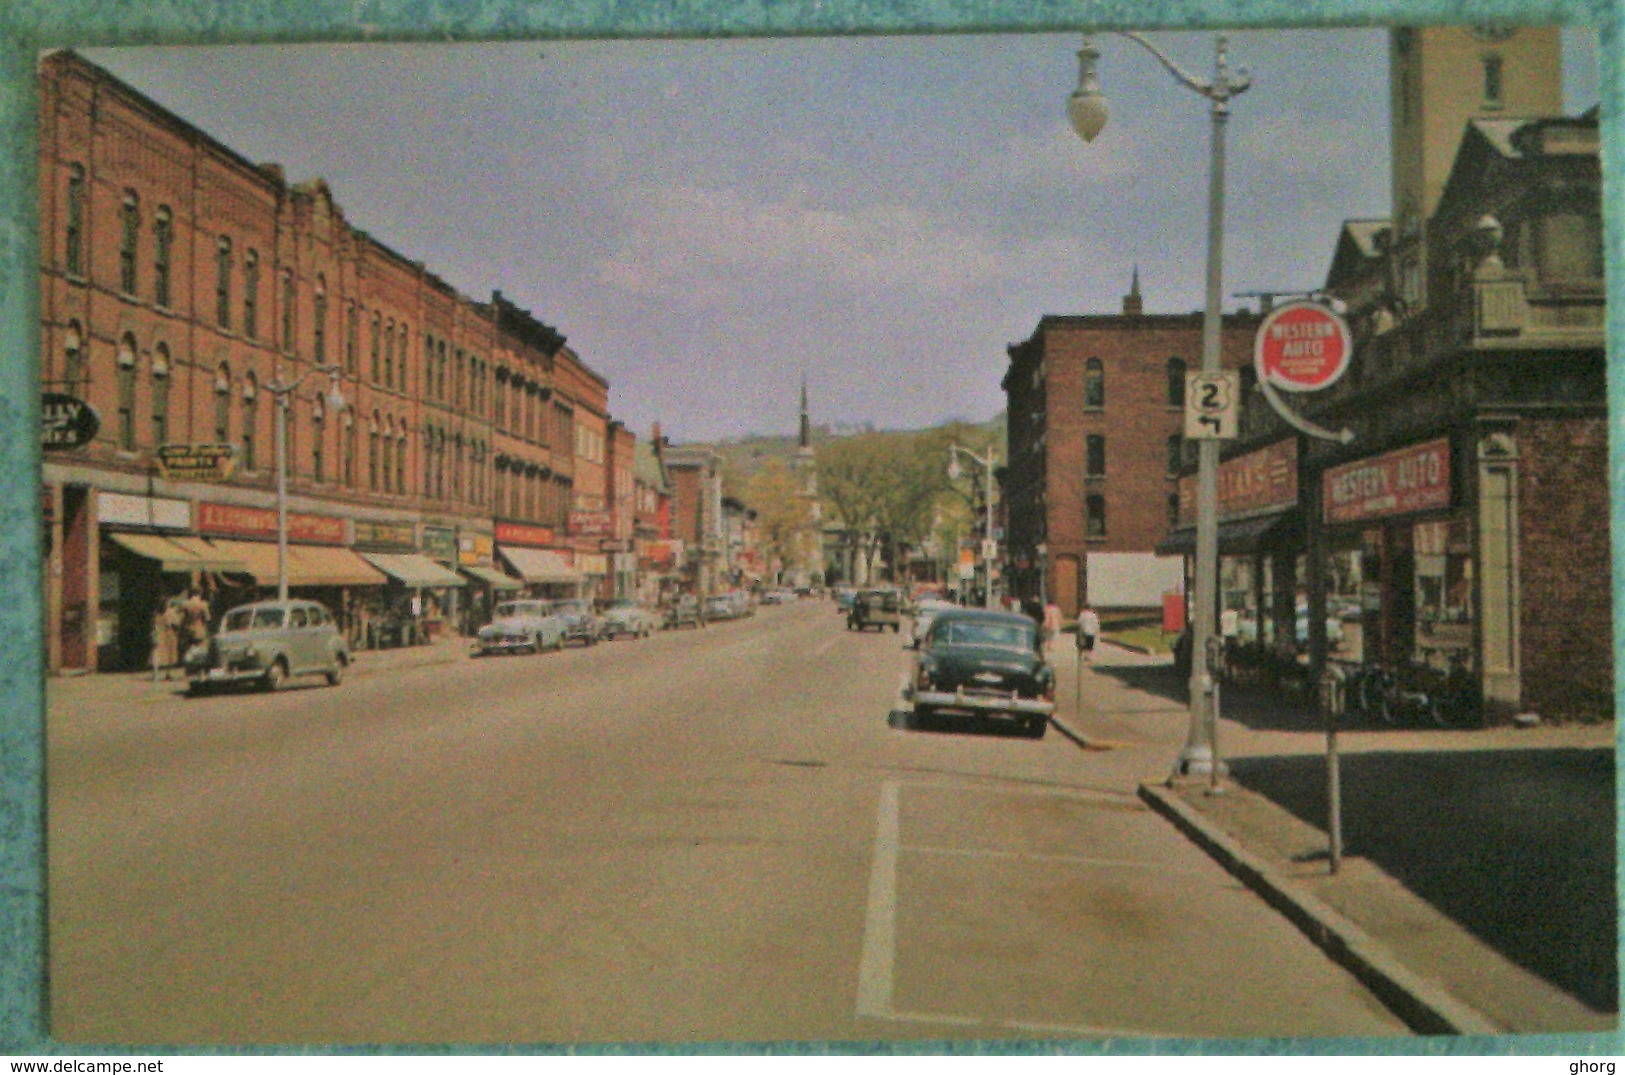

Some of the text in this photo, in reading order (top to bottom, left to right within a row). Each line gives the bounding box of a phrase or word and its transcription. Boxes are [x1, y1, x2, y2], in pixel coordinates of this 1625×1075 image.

[1272, 322, 1335, 340] WESTERN
[1283, 340, 1325, 357] AUTO
[1202, 384, 1220, 407] 2
[1332, 467, 1391, 502] WESTERN
[1398, 451, 1440, 487] AUTO
